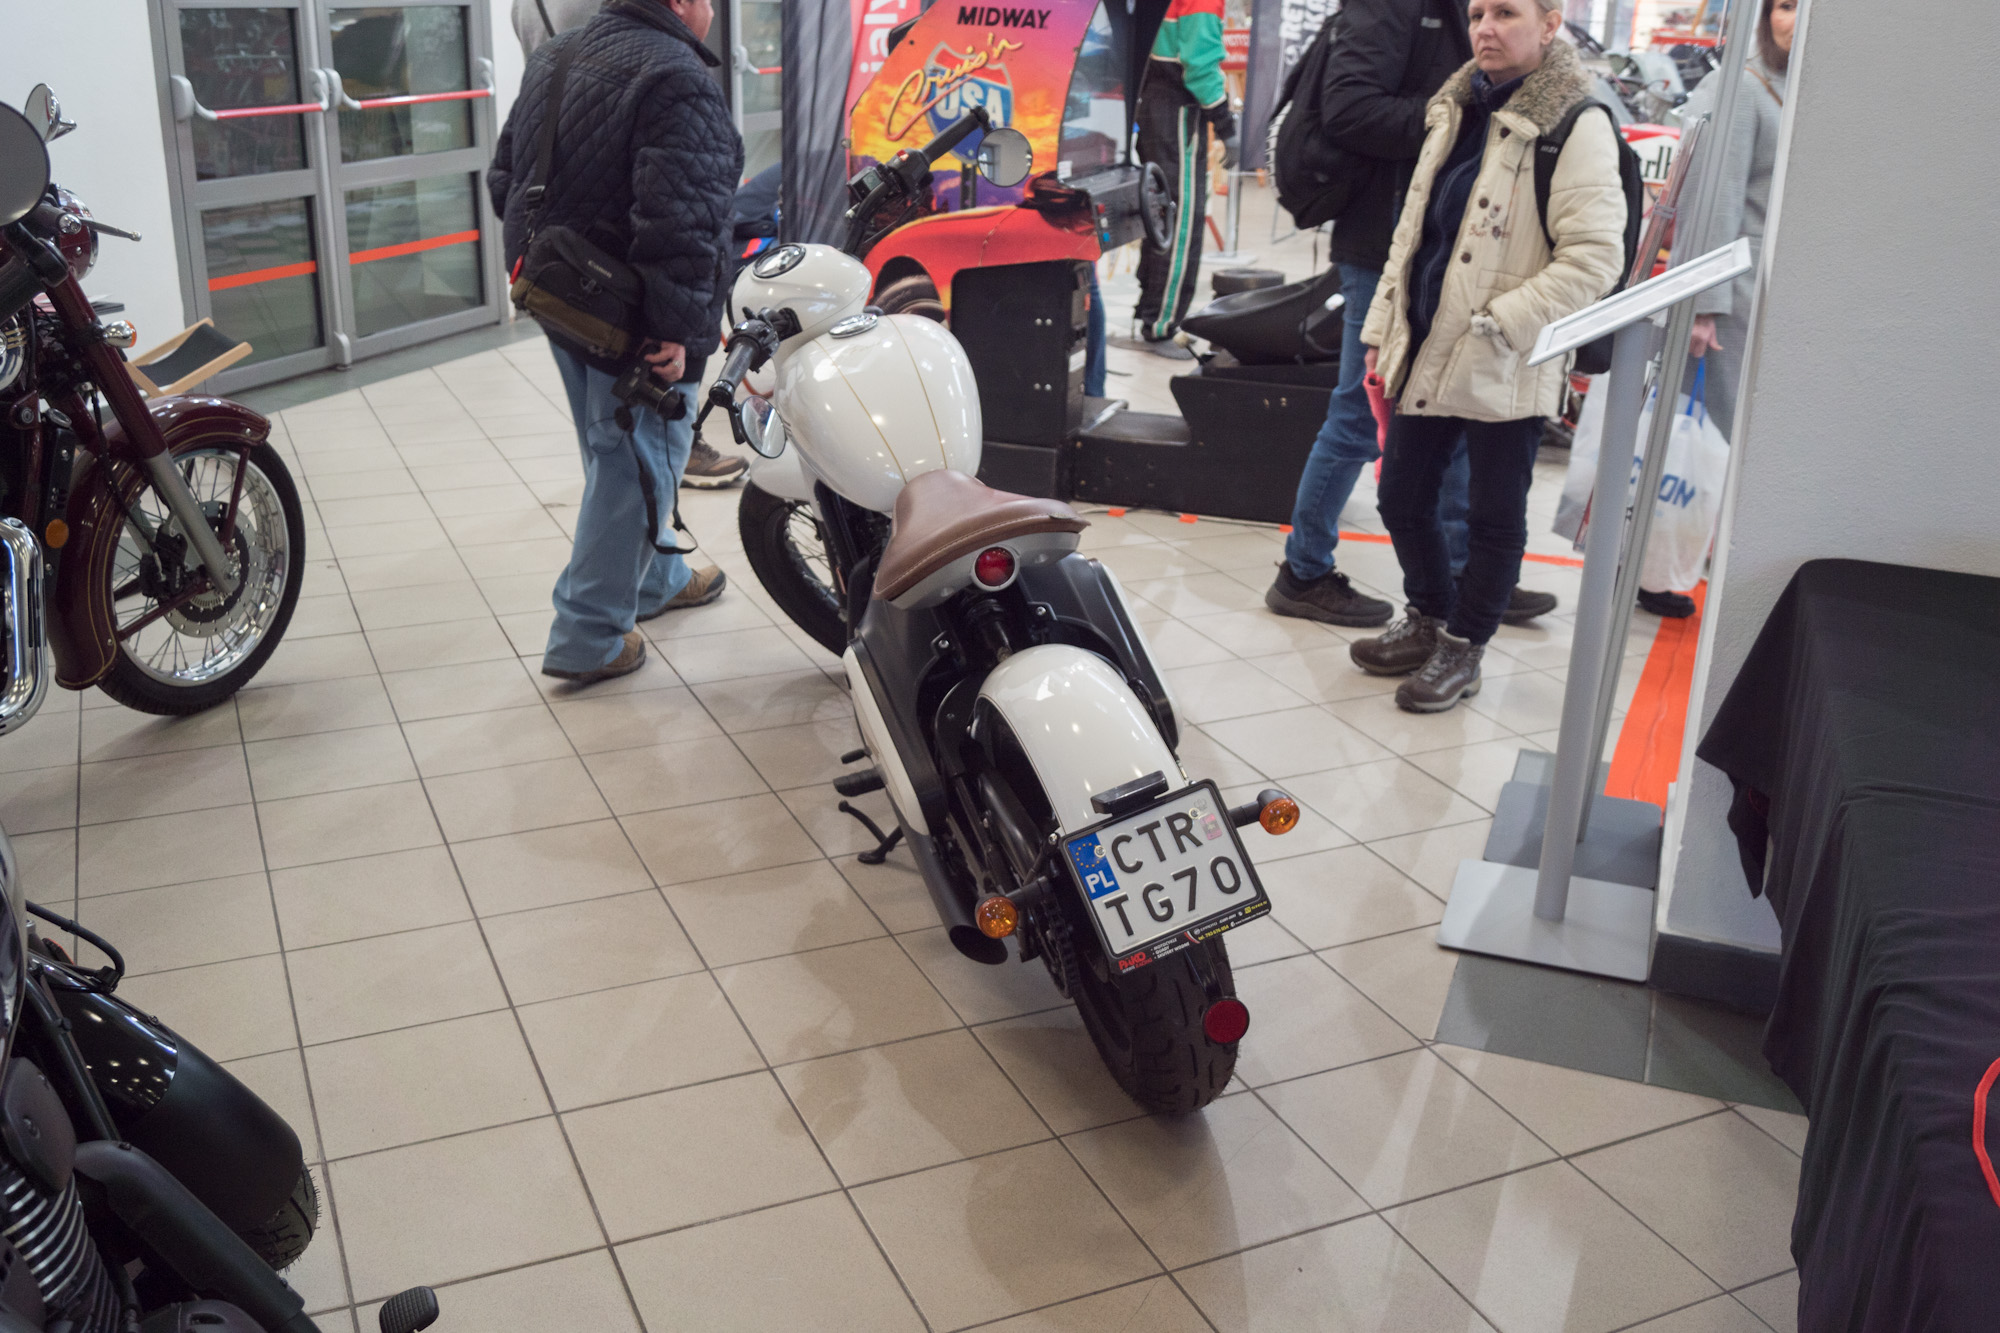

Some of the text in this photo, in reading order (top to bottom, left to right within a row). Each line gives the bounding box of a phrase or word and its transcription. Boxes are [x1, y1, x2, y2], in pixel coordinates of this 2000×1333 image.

[957, 6, 1052, 29] MIDWAY
[936, 78, 1005, 129] USA
[1111, 812, 1203, 873] CTR
[1085, 870, 1115, 894] PL
[1104, 856, 1242, 937] TG70
